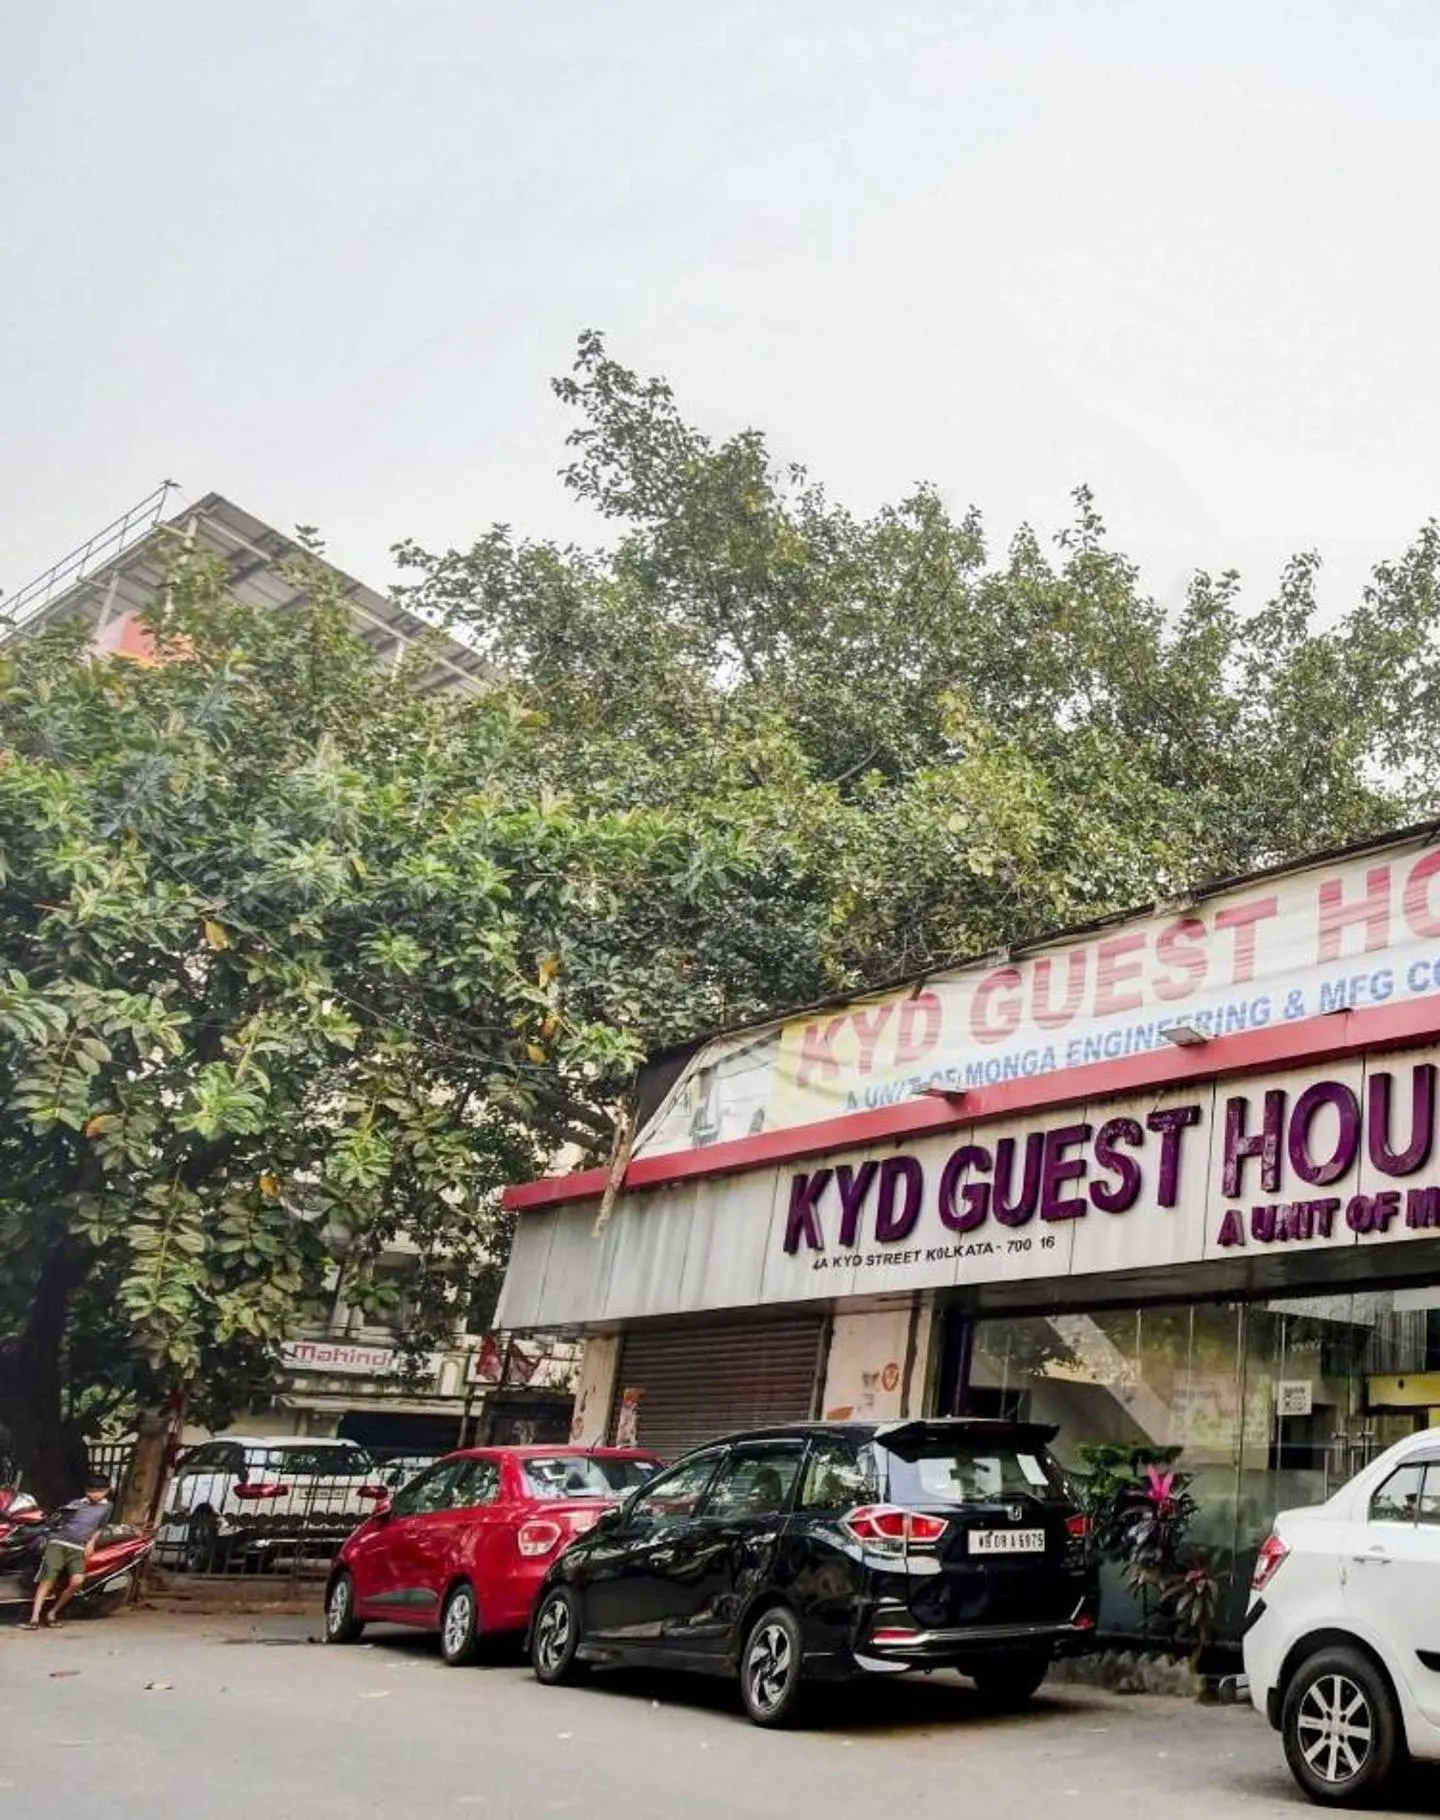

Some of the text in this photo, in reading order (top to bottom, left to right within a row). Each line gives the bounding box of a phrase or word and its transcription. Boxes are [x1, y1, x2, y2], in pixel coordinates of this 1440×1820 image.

[796, 992, 943, 1087] KYD
[969, 897, 1278, 1045] GUEST
[846, 1090, 859, 1111] A
[965, 1046, 1057, 1086] MONGA
[1282, 990, 1306, 1020] &
[1320, 969, 1395, 1011] MFG
[783, 1154, 924, 1255] KYD
[938, 1105, 1200, 1233] GUEST
[1217, 1209, 1246, 1247] A
[1250, 1198, 1341, 1242] UNIT
[1345, 1191, 1401, 1234] OF
[832, 1254, 863, 1268] KYD
[866, 1249, 921, 1266] STREET
[1006, 1237, 1032, 1253] 700
[1040, 1235, 1055, 1249] 16
[292, 1343, 408, 1368] Mahindr
